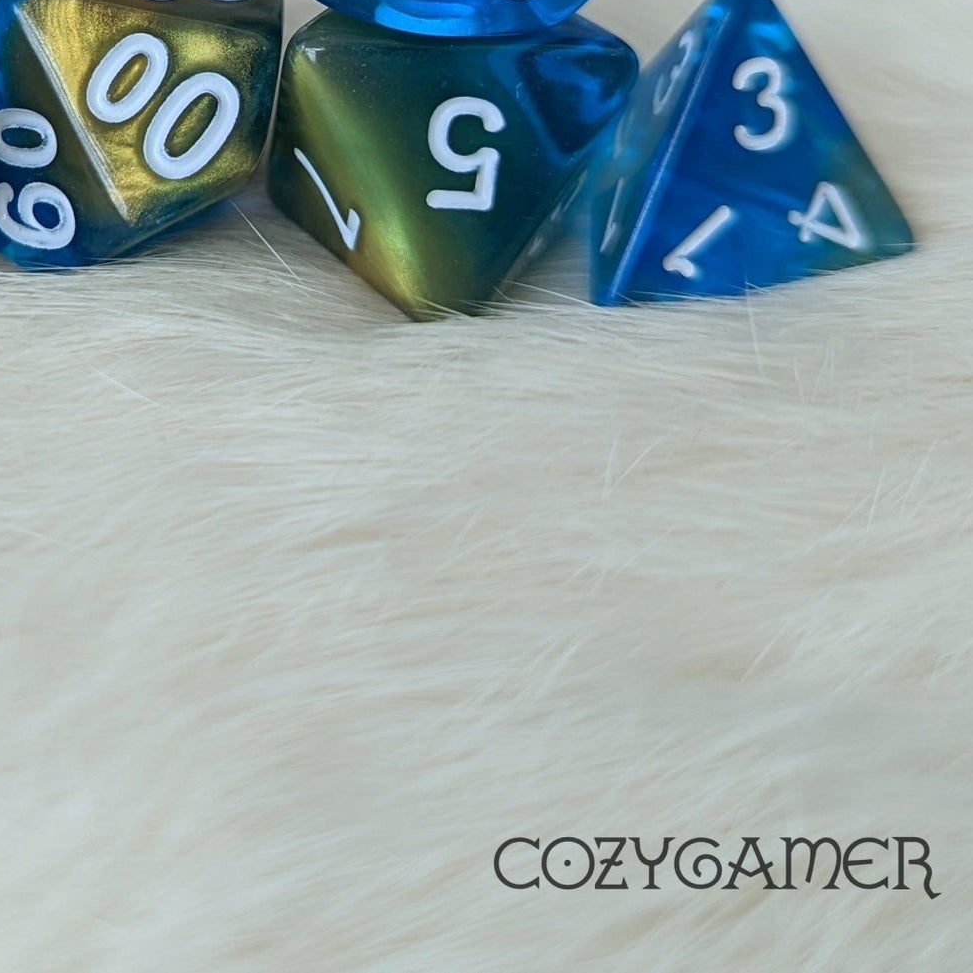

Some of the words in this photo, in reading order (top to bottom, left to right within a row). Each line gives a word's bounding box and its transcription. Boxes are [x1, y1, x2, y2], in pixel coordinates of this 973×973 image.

[86, 32, 240, 180] 00
[732, 56, 790, 152] 3
[426, 96, 506, 212] 5
[662, 205, 734, 279] 1
[787, 181, 863, 250] 4
